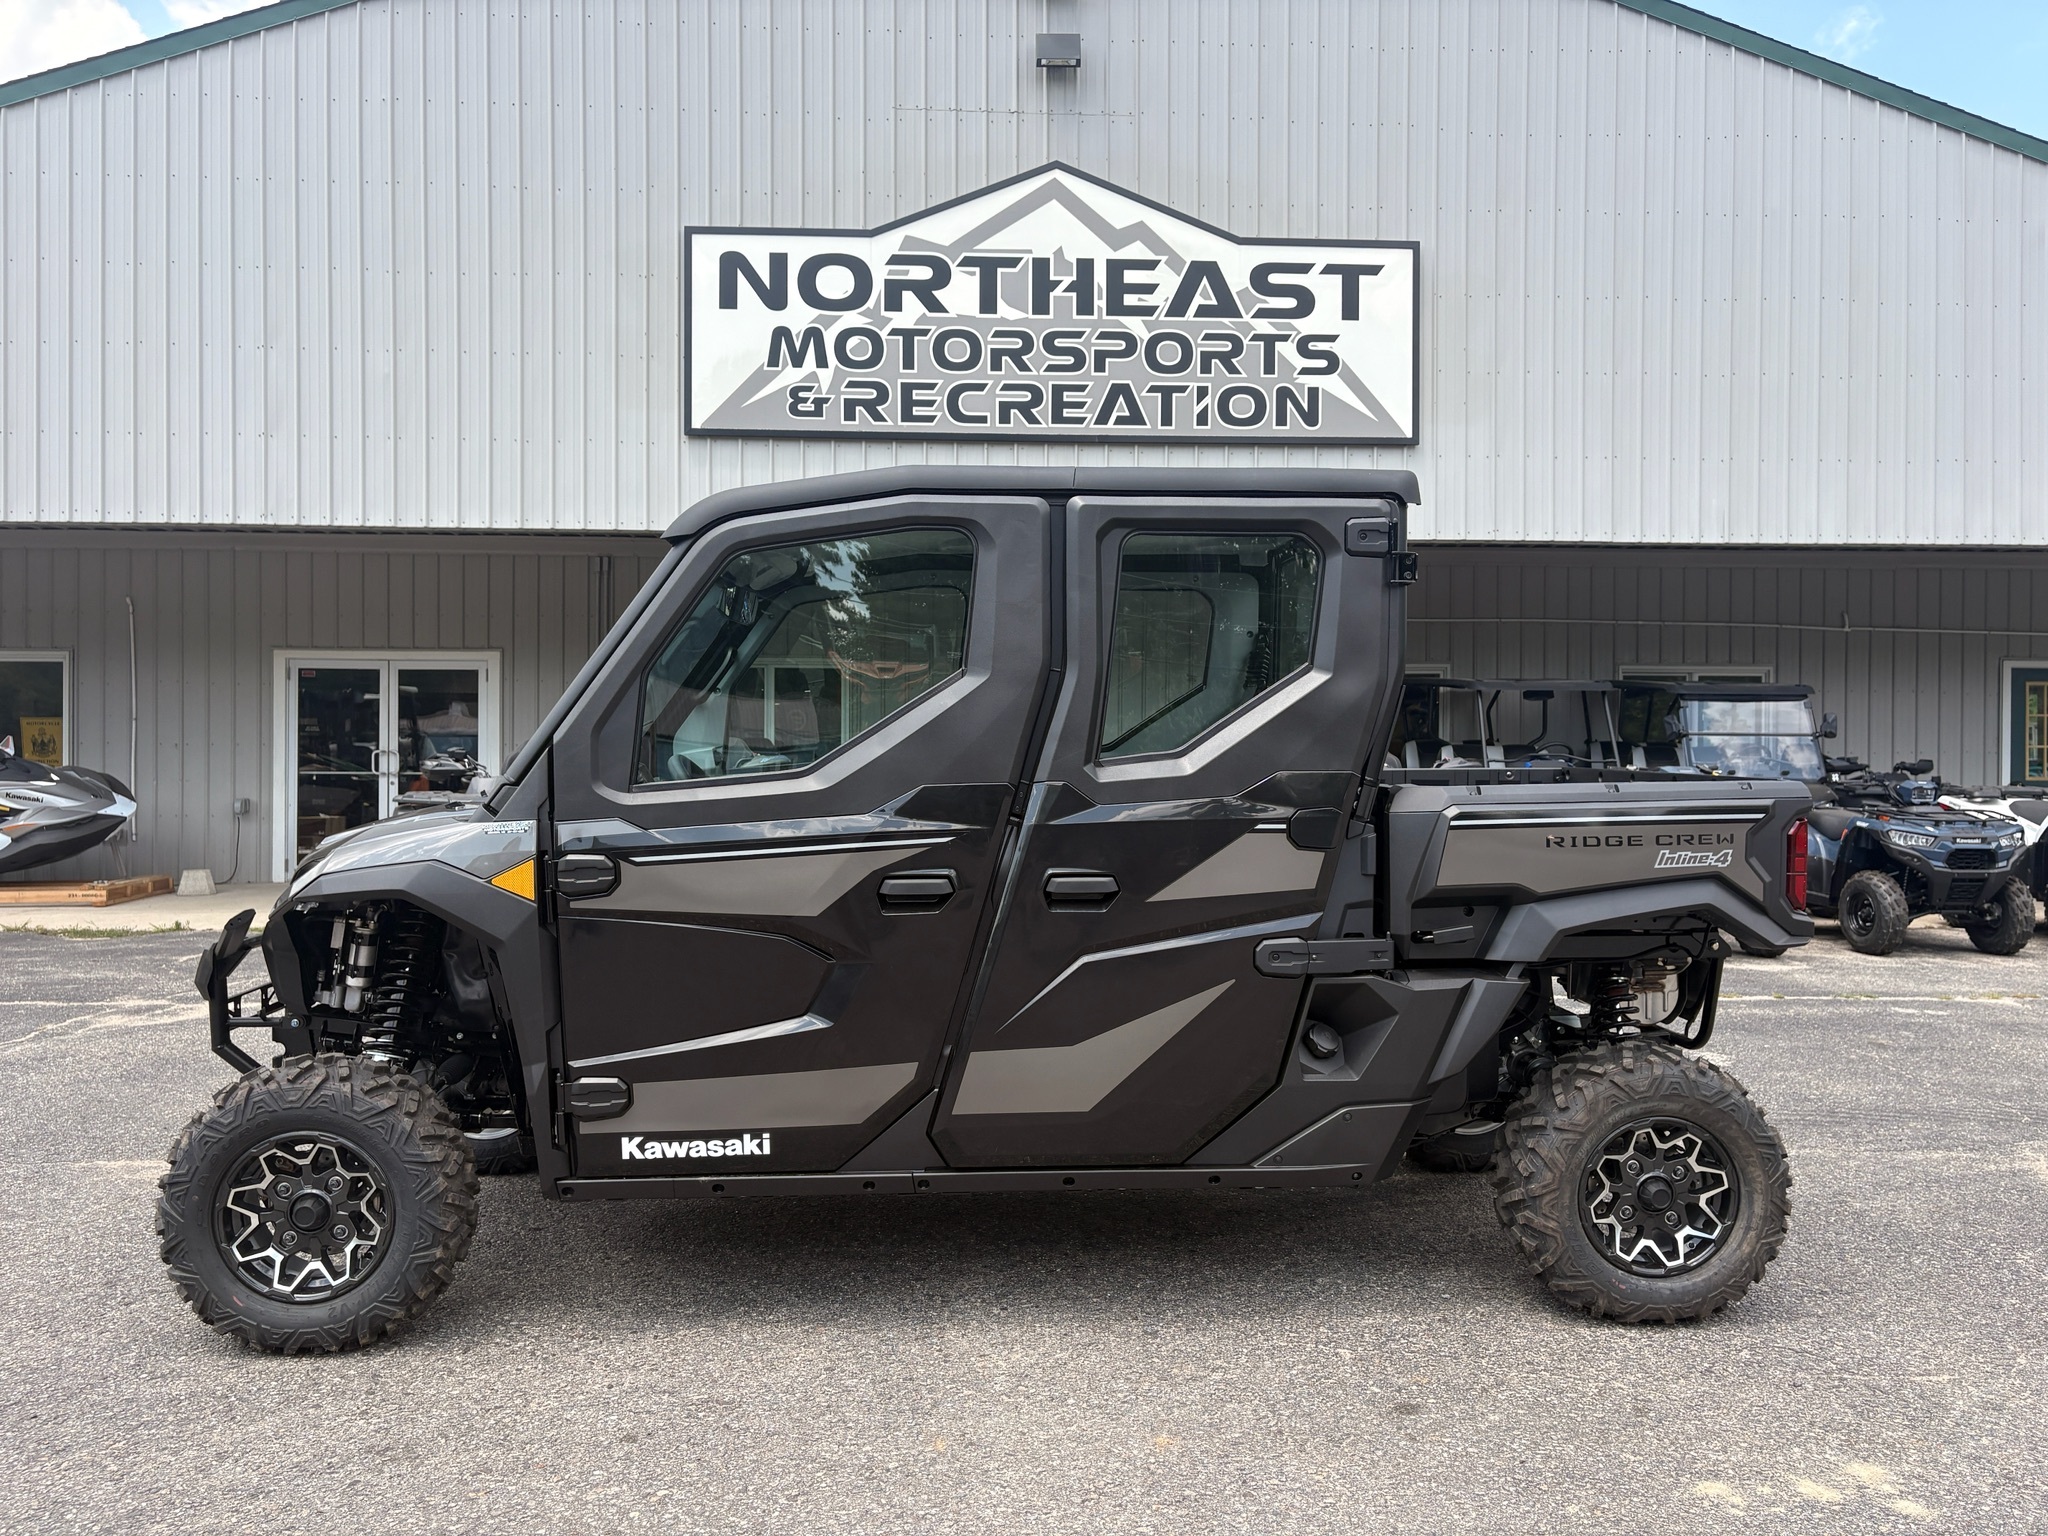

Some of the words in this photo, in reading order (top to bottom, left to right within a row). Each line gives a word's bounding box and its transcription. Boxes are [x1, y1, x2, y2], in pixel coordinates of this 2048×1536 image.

[720, 252, 1385, 321] NORTHEAST
[767, 326, 1340, 376] MOTORSPORTS
[788, 385, 831, 418] &
[843, 380, 1320, 428] RECREATION
[5, 791, 44, 803] Kawasaki
[1545, 835, 1644, 848] RIDGE
[1655, 833, 1734, 846] CREW
[621, 1133, 771, 1160] Kawasaki
